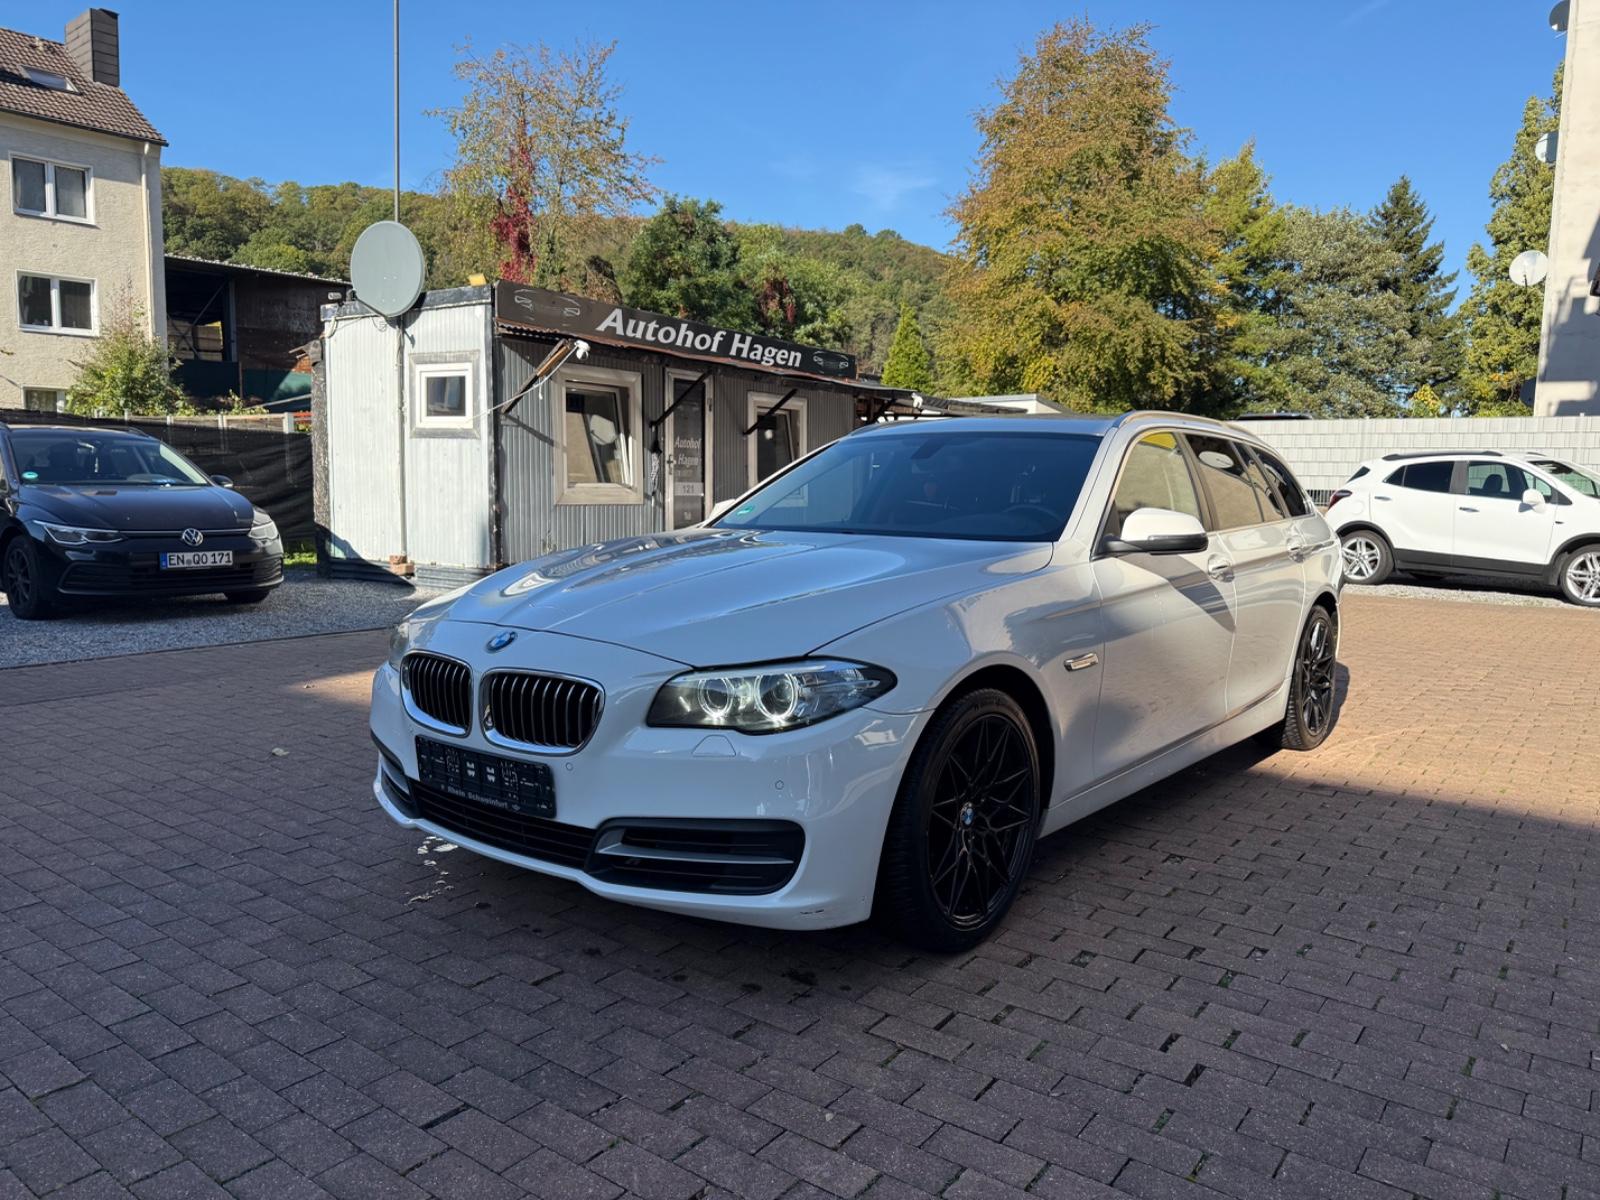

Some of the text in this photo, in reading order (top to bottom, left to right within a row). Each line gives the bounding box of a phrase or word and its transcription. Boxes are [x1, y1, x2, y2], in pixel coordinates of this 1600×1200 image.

[596, 308, 802, 368] Autohof Hagen
[674, 436, 702, 449] Autohof
[682, 485, 695, 494] 121
[168, 554, 185, 566] EN
[211, 552, 232, 564] 171
